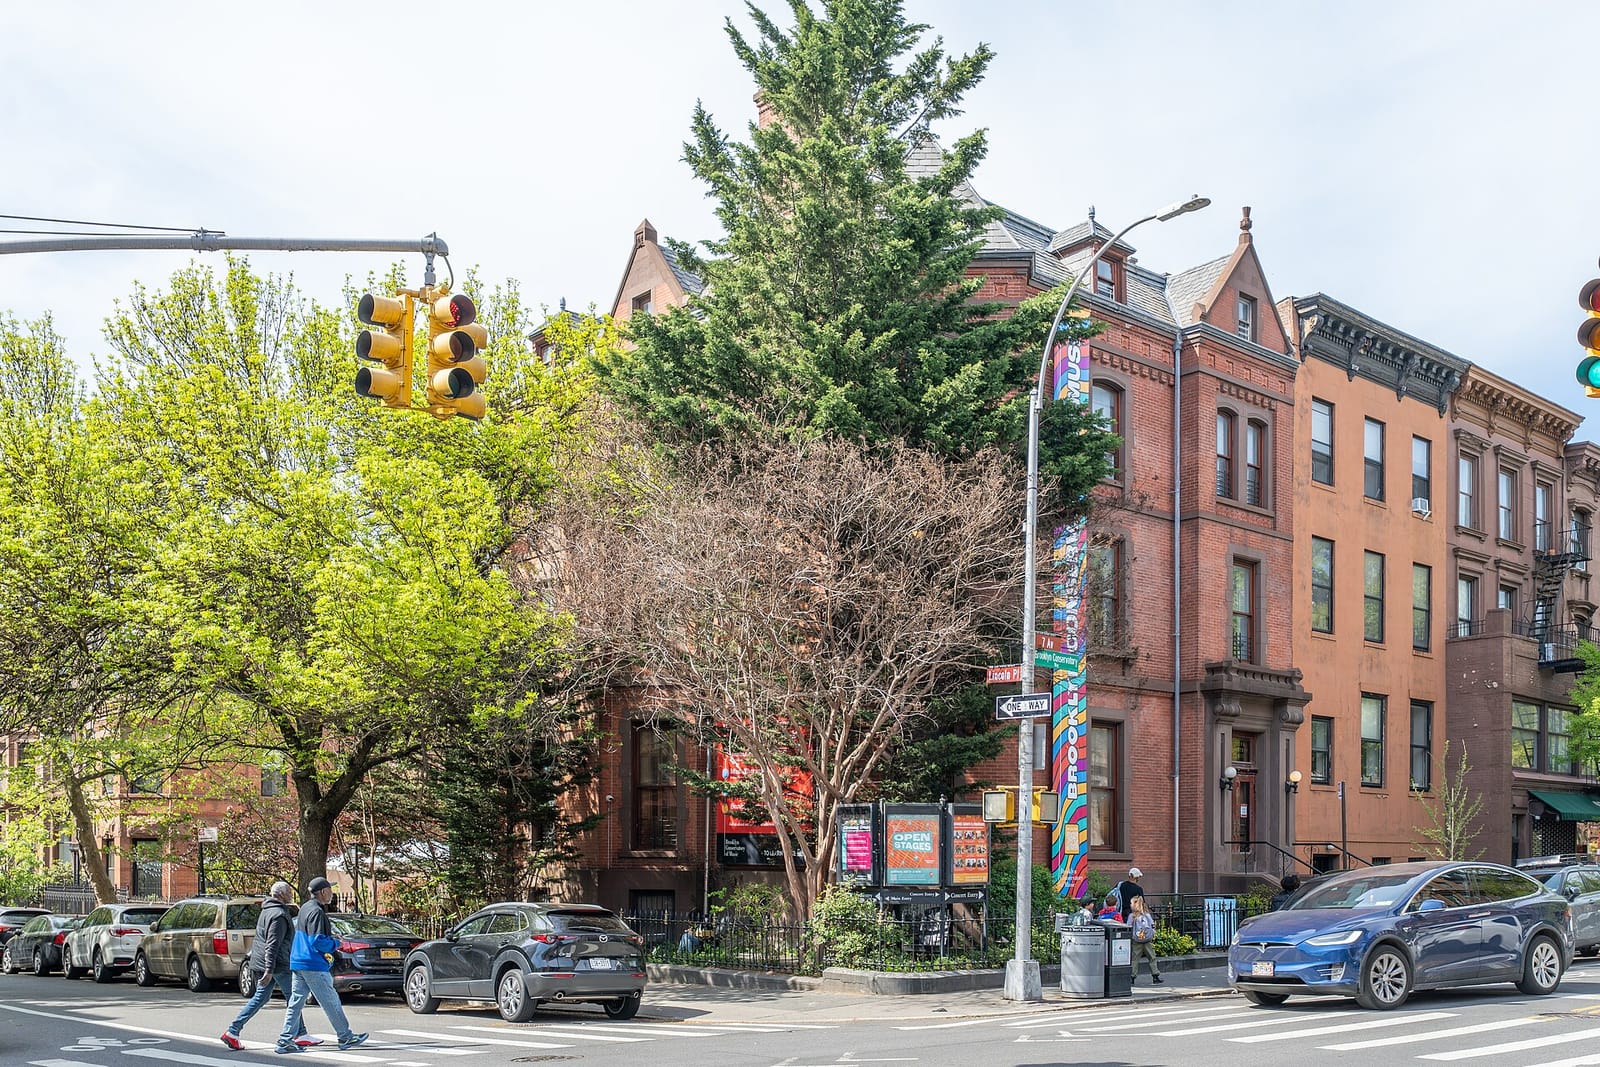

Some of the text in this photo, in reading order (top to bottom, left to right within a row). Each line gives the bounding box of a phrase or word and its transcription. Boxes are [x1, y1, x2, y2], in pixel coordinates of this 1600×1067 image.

[1041, 637, 1045, 648] 7
[1053, 653, 1078, 668] Conservatory
[988, 668, 1020, 681] Lincoln Pl
[1006, 700, 1045, 711] ONE WAY
[893, 832, 931, 842] OPEN
[894, 842, 932, 851] STAGES
